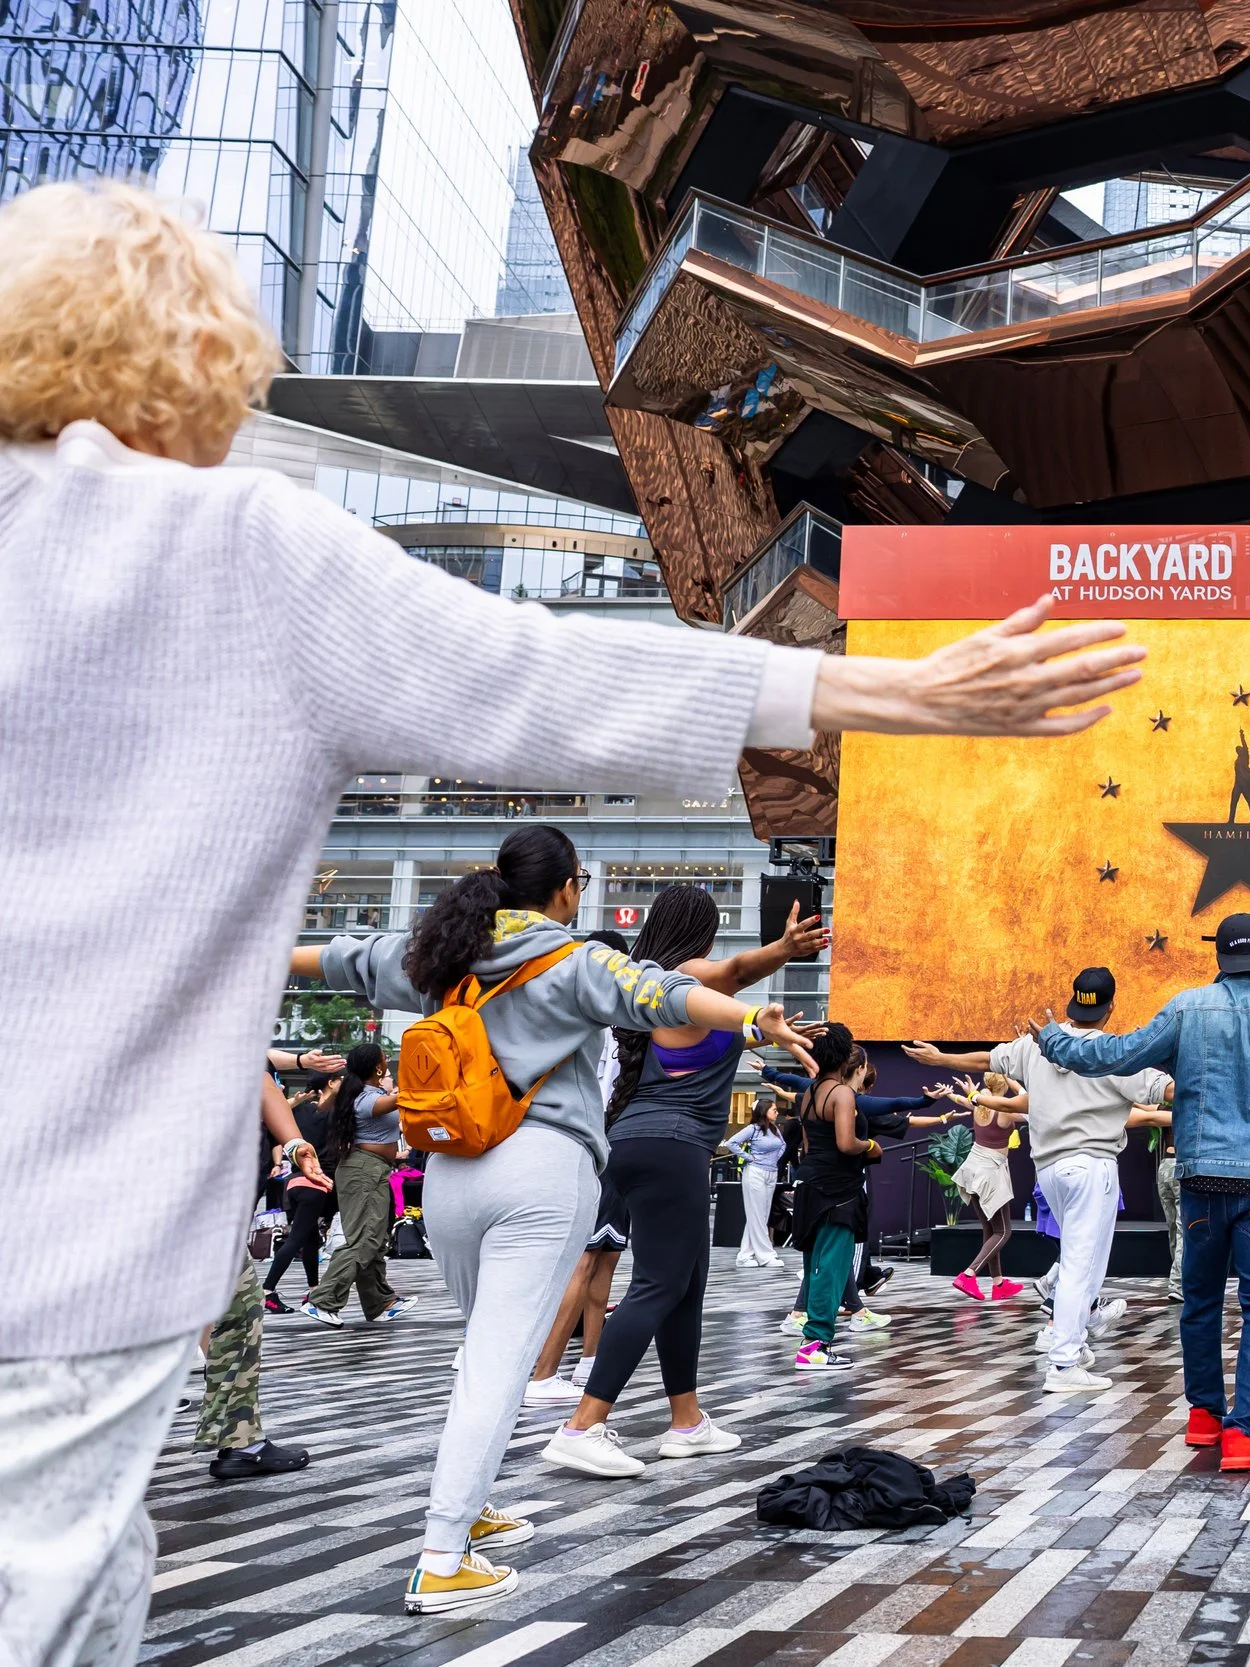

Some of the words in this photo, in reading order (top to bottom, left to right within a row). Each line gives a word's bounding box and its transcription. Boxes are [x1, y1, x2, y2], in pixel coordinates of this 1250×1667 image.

[1050, 543, 1233, 581] BACKYARD
[1050, 586, 1074, 601] AT
[1079, 585, 1164, 601] HUDSON
[1169, 585, 1232, 601] YARDS
